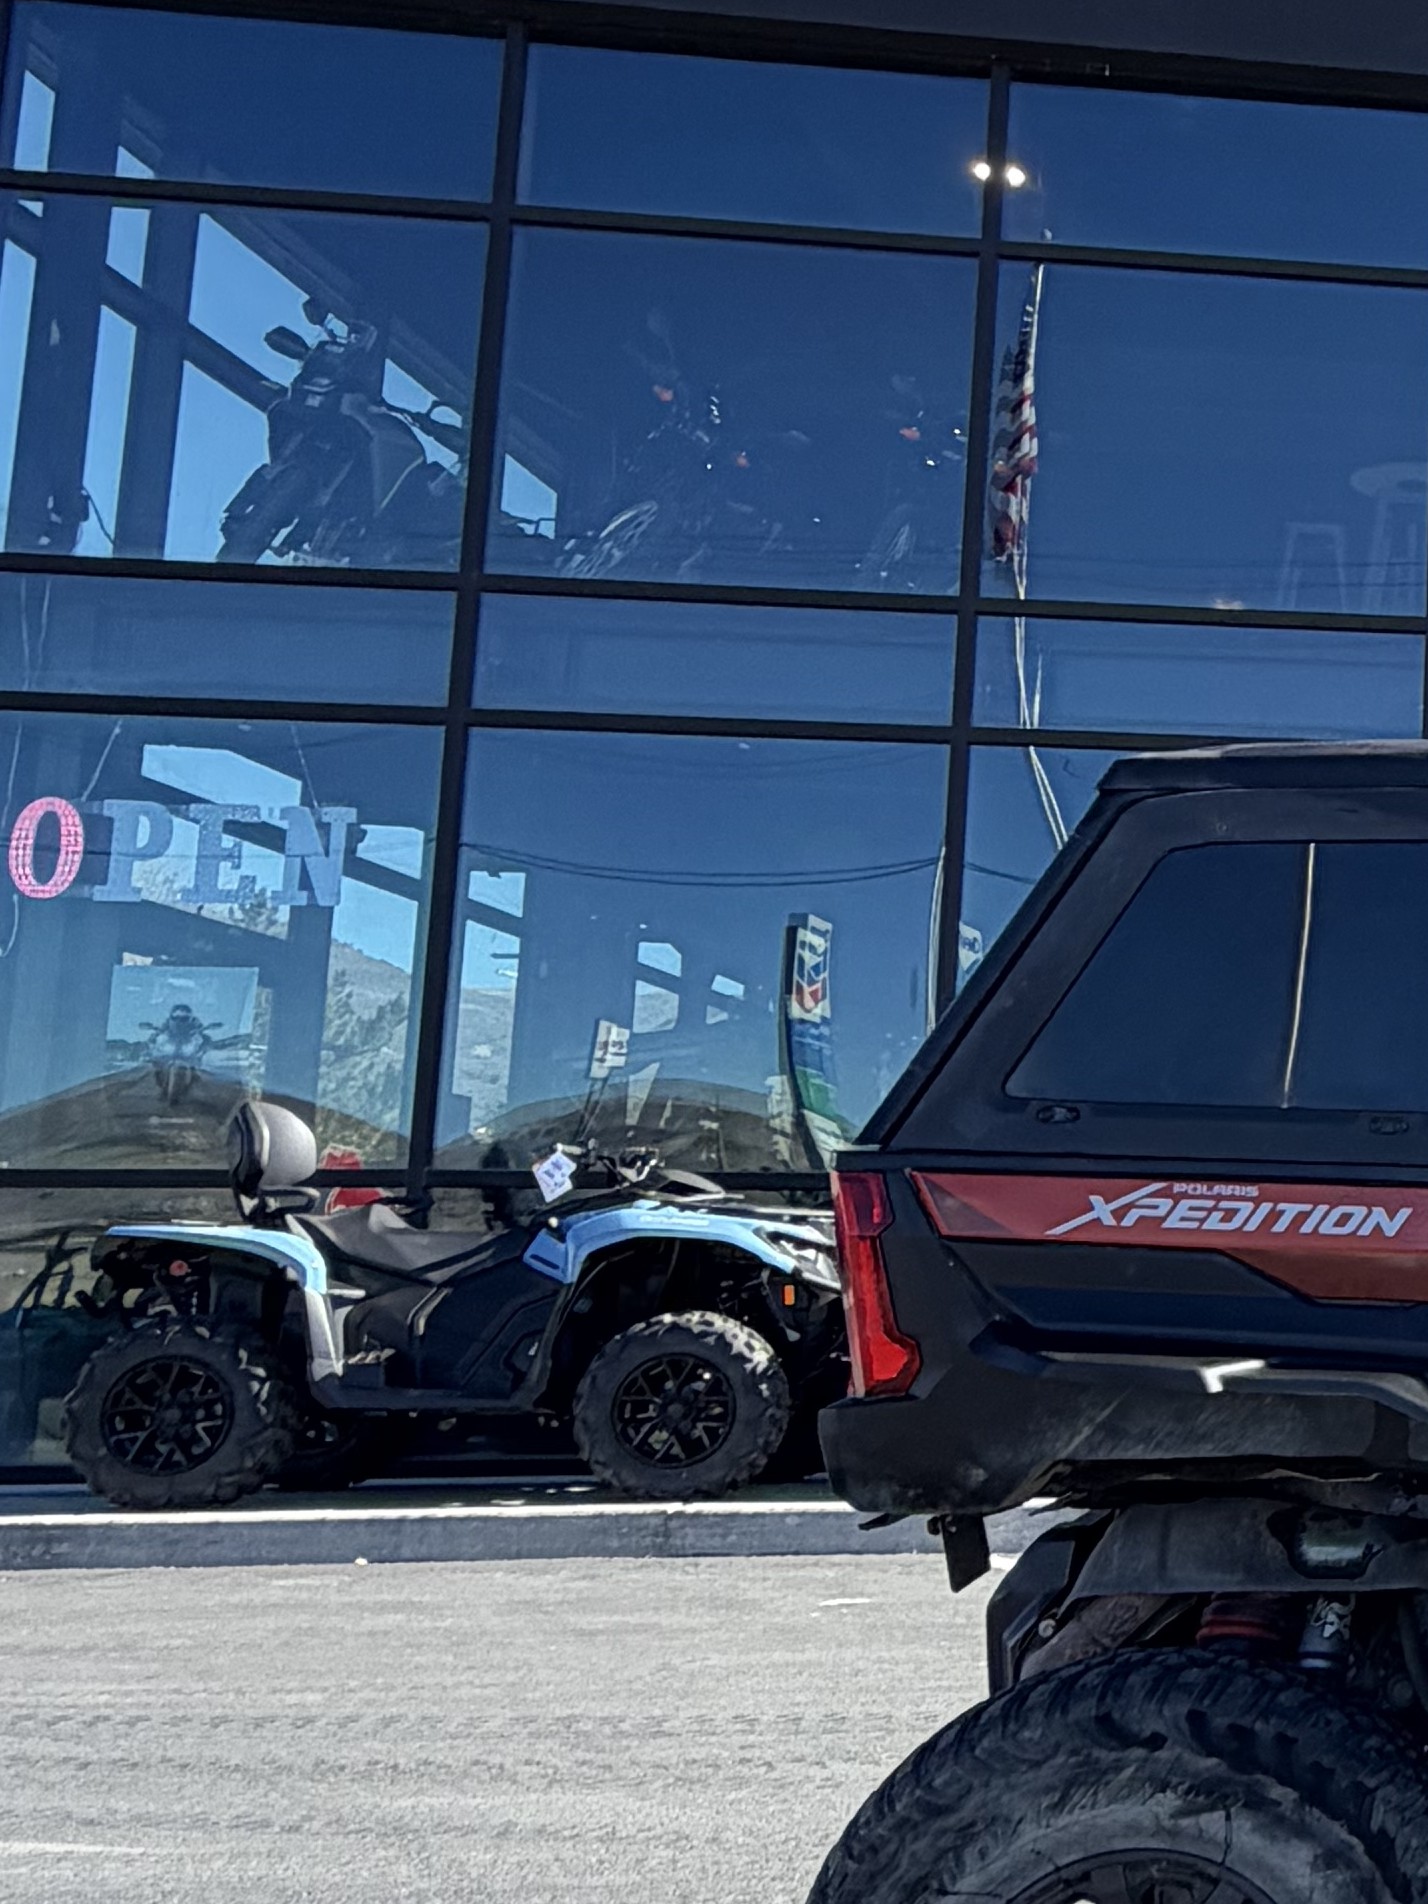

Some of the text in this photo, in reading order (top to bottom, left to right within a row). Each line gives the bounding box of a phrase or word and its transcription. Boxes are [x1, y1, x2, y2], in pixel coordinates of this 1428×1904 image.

[8, 796, 357, 906] OPEN
[1044, 1182, 1413, 1238] XPEDITION
[1172, 1182, 1260, 1198] POLARIS
